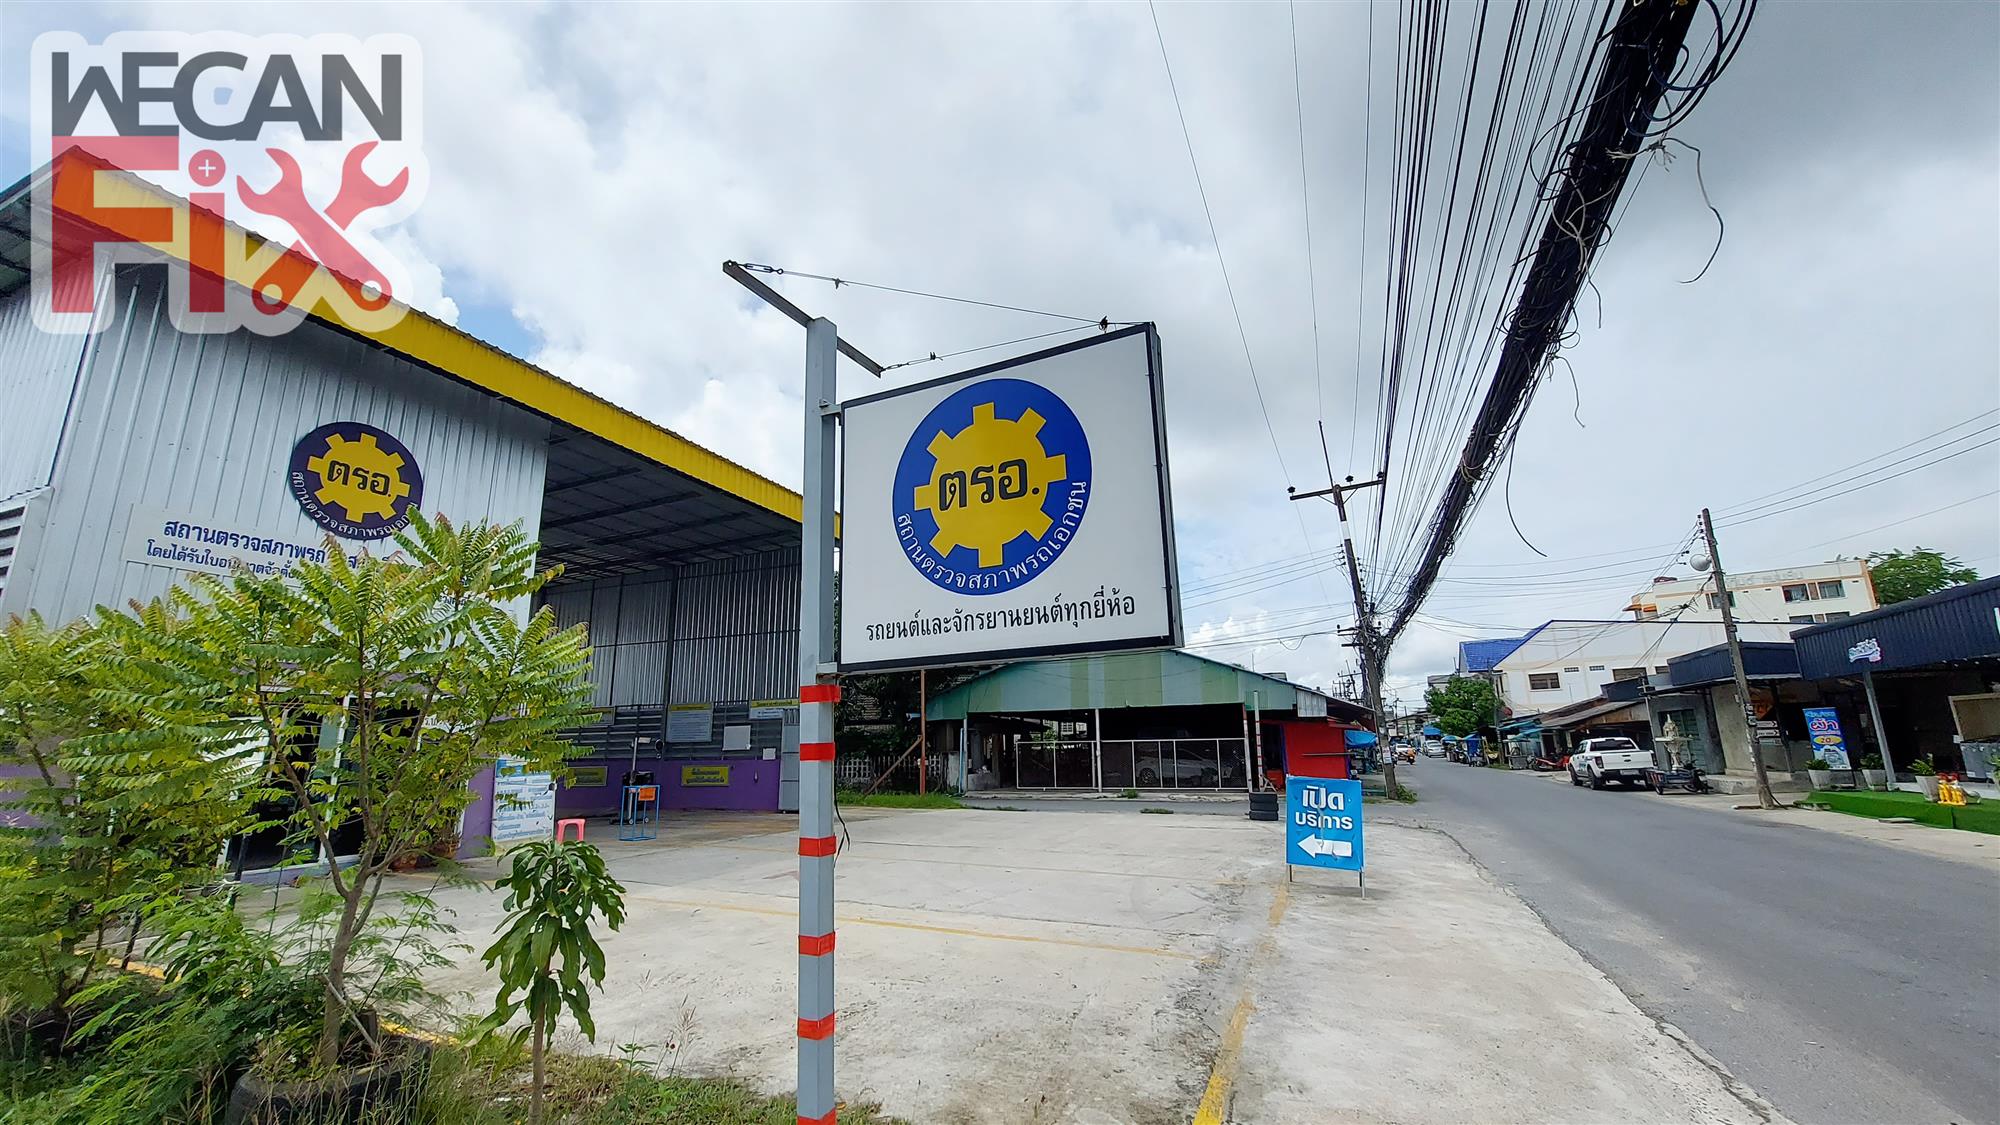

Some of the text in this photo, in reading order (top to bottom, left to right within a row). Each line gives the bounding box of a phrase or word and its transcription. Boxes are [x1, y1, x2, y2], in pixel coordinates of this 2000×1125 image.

[327, 459, 392, 498] ตรอ.
[938, 459, 1040, 512] ตรอ.
[897, 481, 1087, 589] สถานตรวจสภาพรถเอกชน
[866, 585, 1135, 641] รถยนต์และจักรยานยนต์ทุกยี่ห้อ
[1296, 810, 1353, 830] บริการ
[1303, 785, 1344, 811] เปิด
